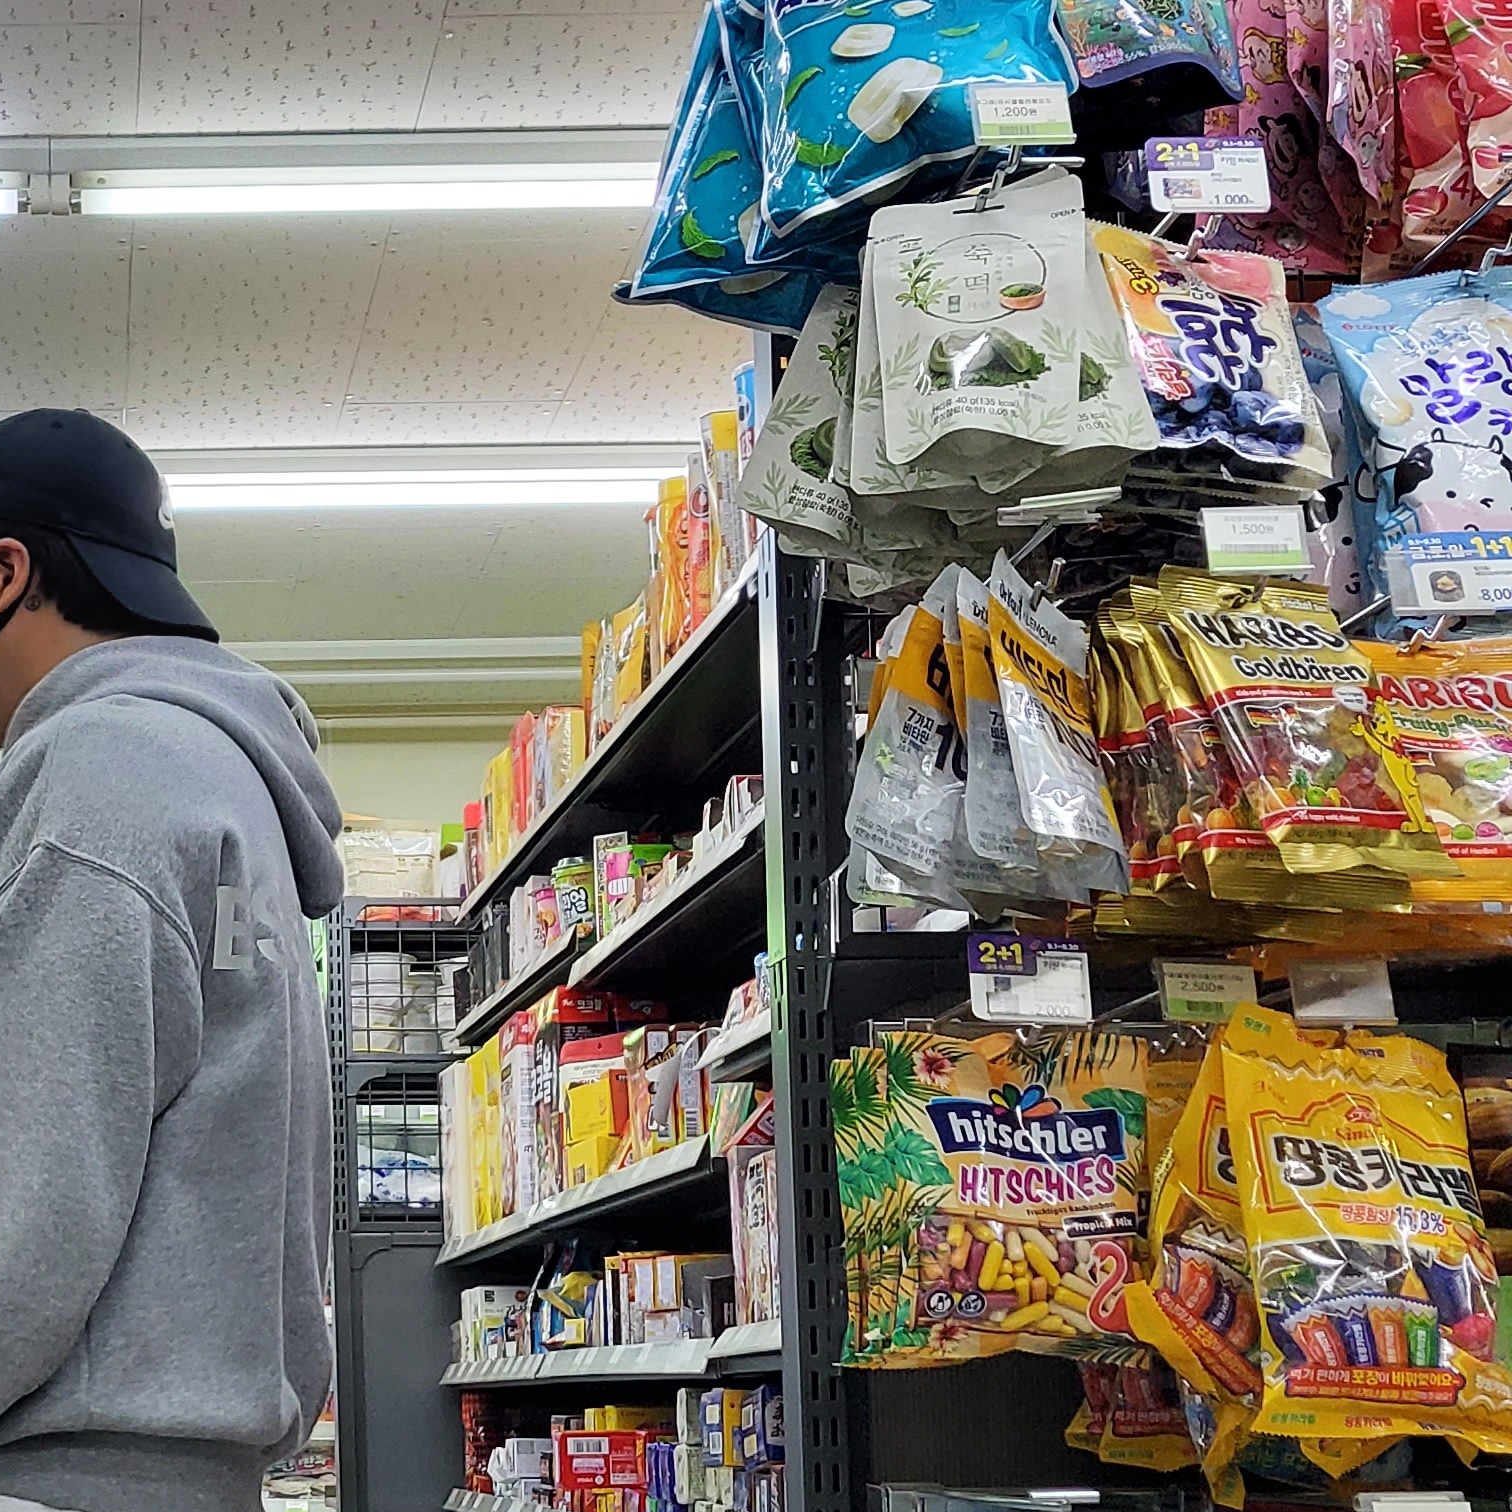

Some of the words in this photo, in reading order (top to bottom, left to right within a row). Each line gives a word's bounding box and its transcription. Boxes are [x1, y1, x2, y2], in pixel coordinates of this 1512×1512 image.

[1155, 142, 1201, 163] 2+1
[1051, 209, 1071, 219] OPEN
[1230, 522, 1274, 535] 1,500원
[1186, 610, 1349, 652] HARIBO
[1233, 655, 1369, 682] Goldbären
[979, 941, 1024, 966] 2+1
[947, 1110, 1108, 1155] hitschler
[959, 1155, 1116, 1206] HITSCHIES
[1271, 1135, 1485, 1221] 땅콩카라멜
[1072, 1215, 1113, 1233] Tropical
[1114, 1214, 1134, 1229] Mix
